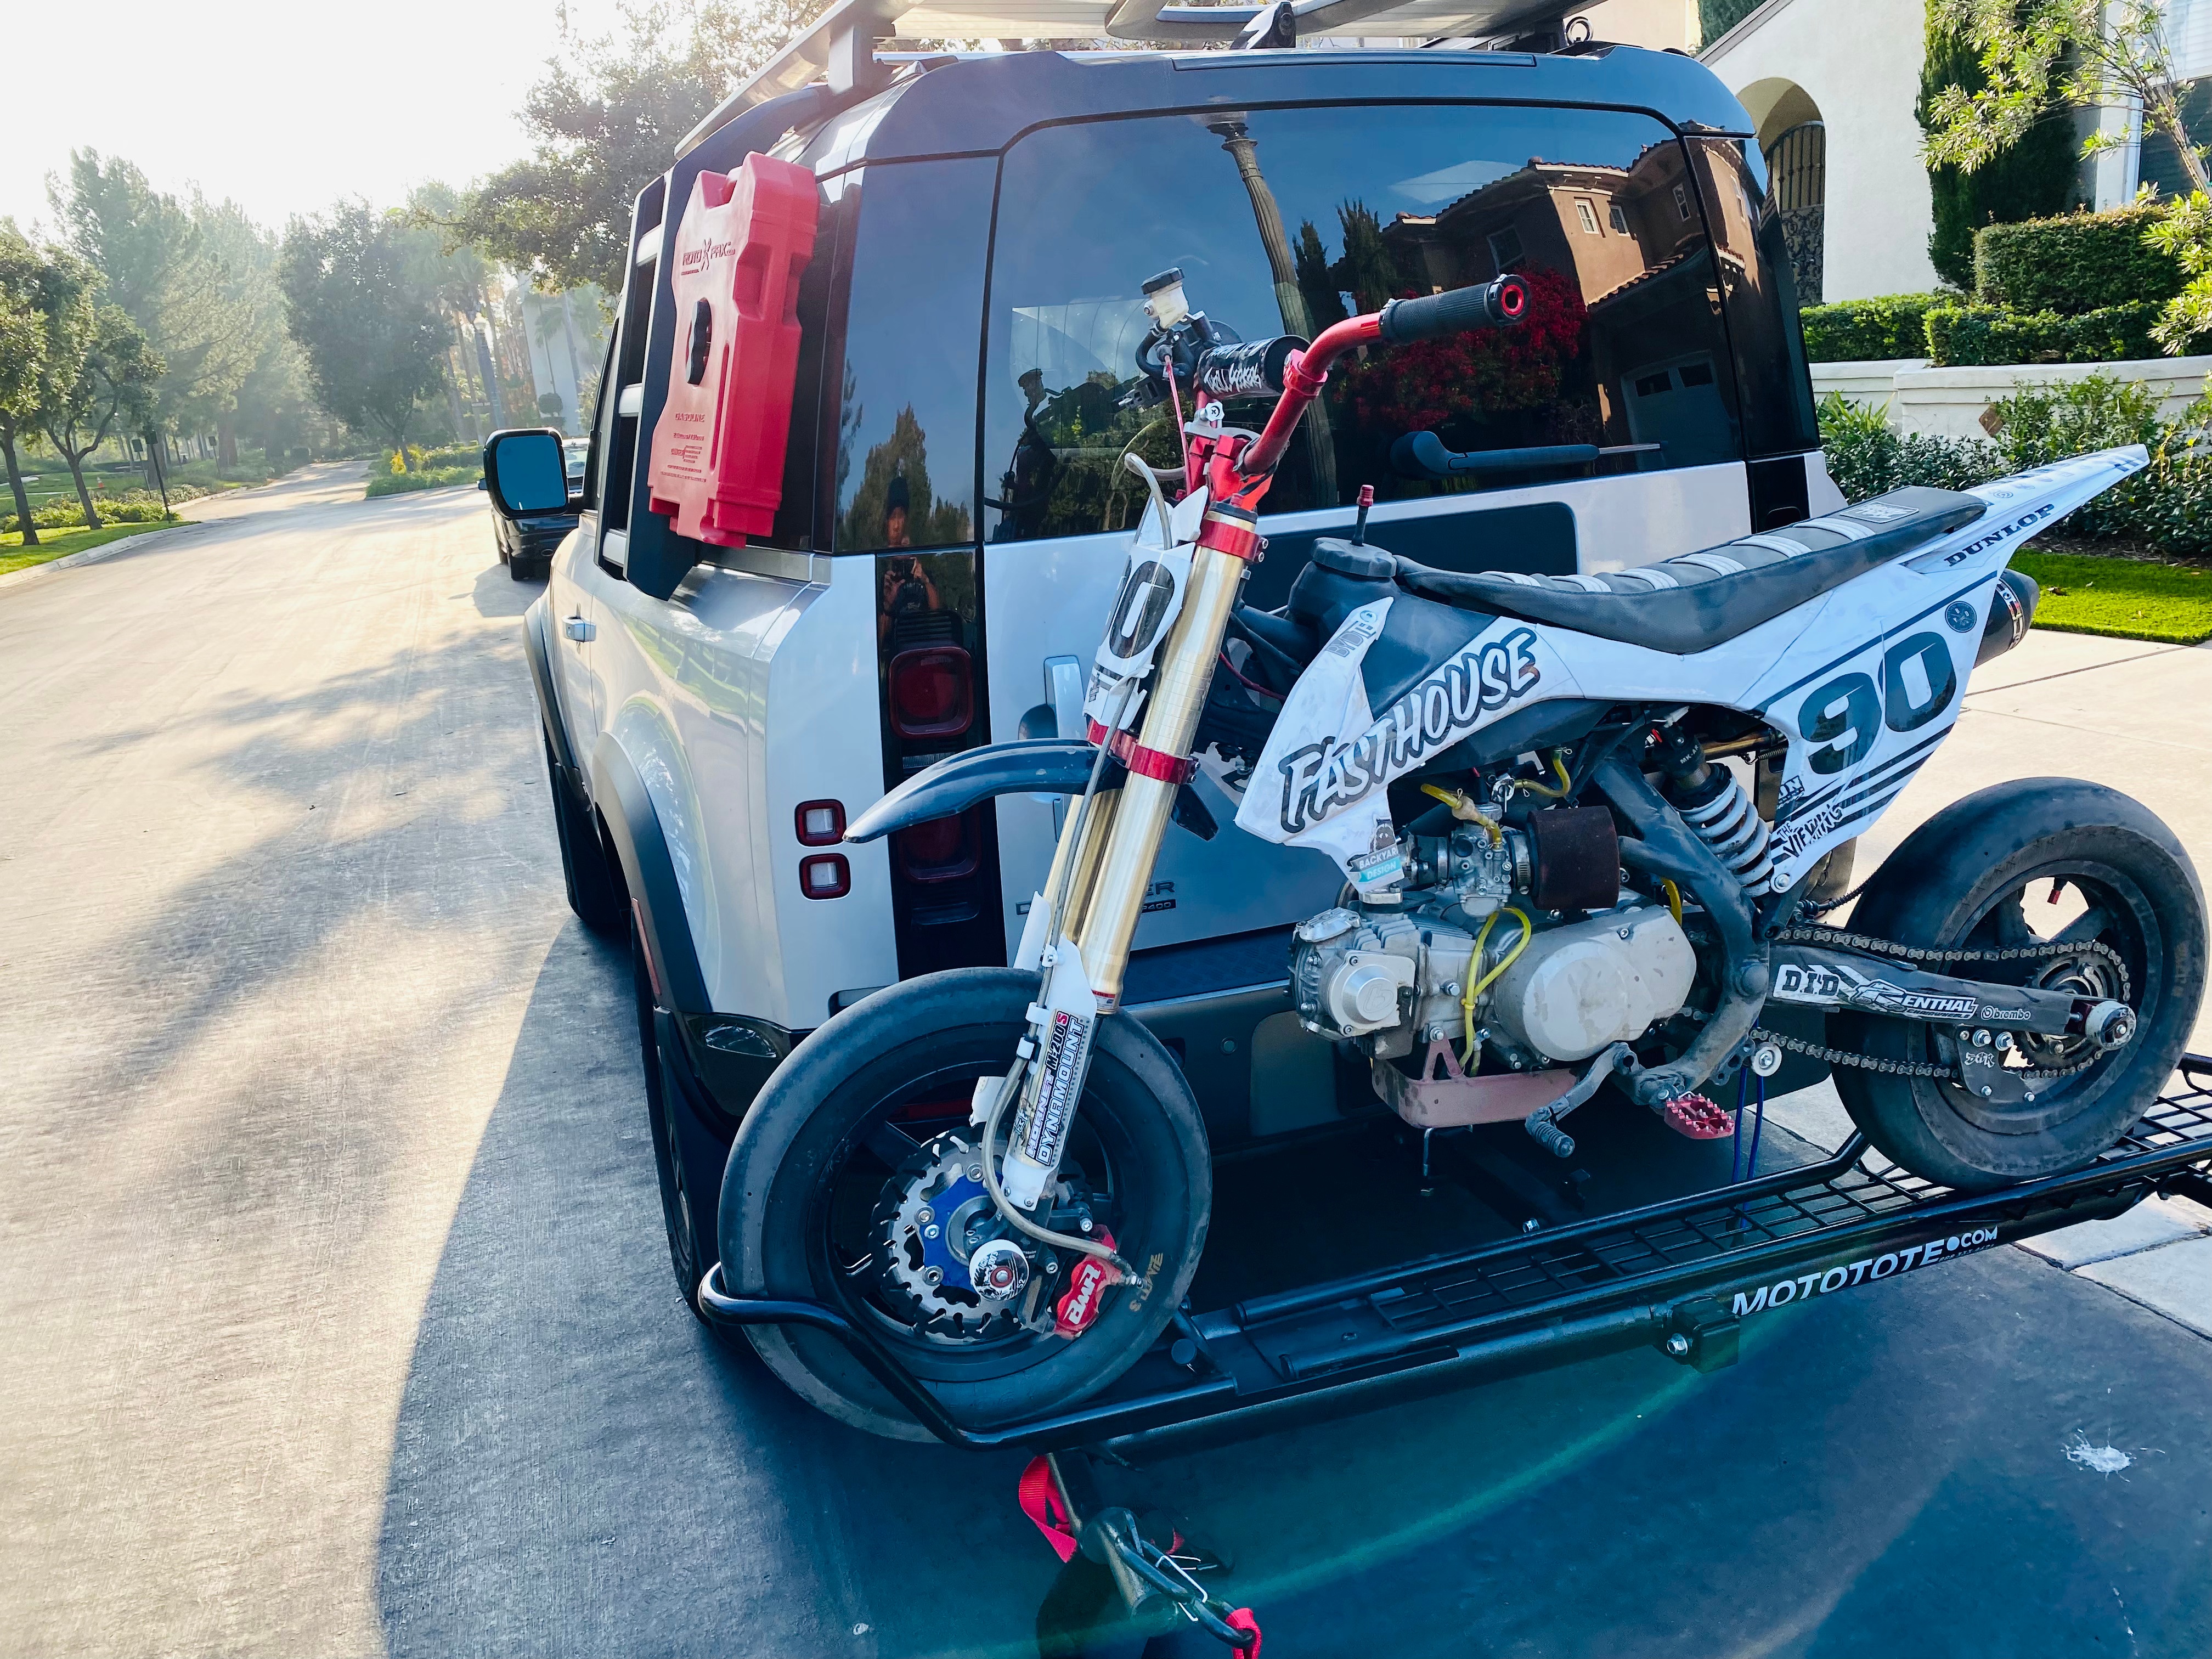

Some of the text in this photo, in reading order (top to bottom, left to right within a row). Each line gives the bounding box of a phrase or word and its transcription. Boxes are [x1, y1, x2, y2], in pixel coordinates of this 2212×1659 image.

[675, 413, 705, 422] GASOLINE
[1944, 504, 2055, 567] DUNLOP
[1798, 631, 1957, 775] 90
[1278, 627, 1540, 833] FASTHOUSE
[1776, 823, 1793, 839] THE
[1359, 847, 1397, 869] BACKYAR
[1367, 861, 1396, 879] DESIGN
[1859, 980, 1975, 1013] RENTHAL
[1994, 1008, 2031, 1020] brembo
[1035, 1014, 1085, 1166] DYNAMOUNT
[1025, 1068, 1055, 1159] HORNET
